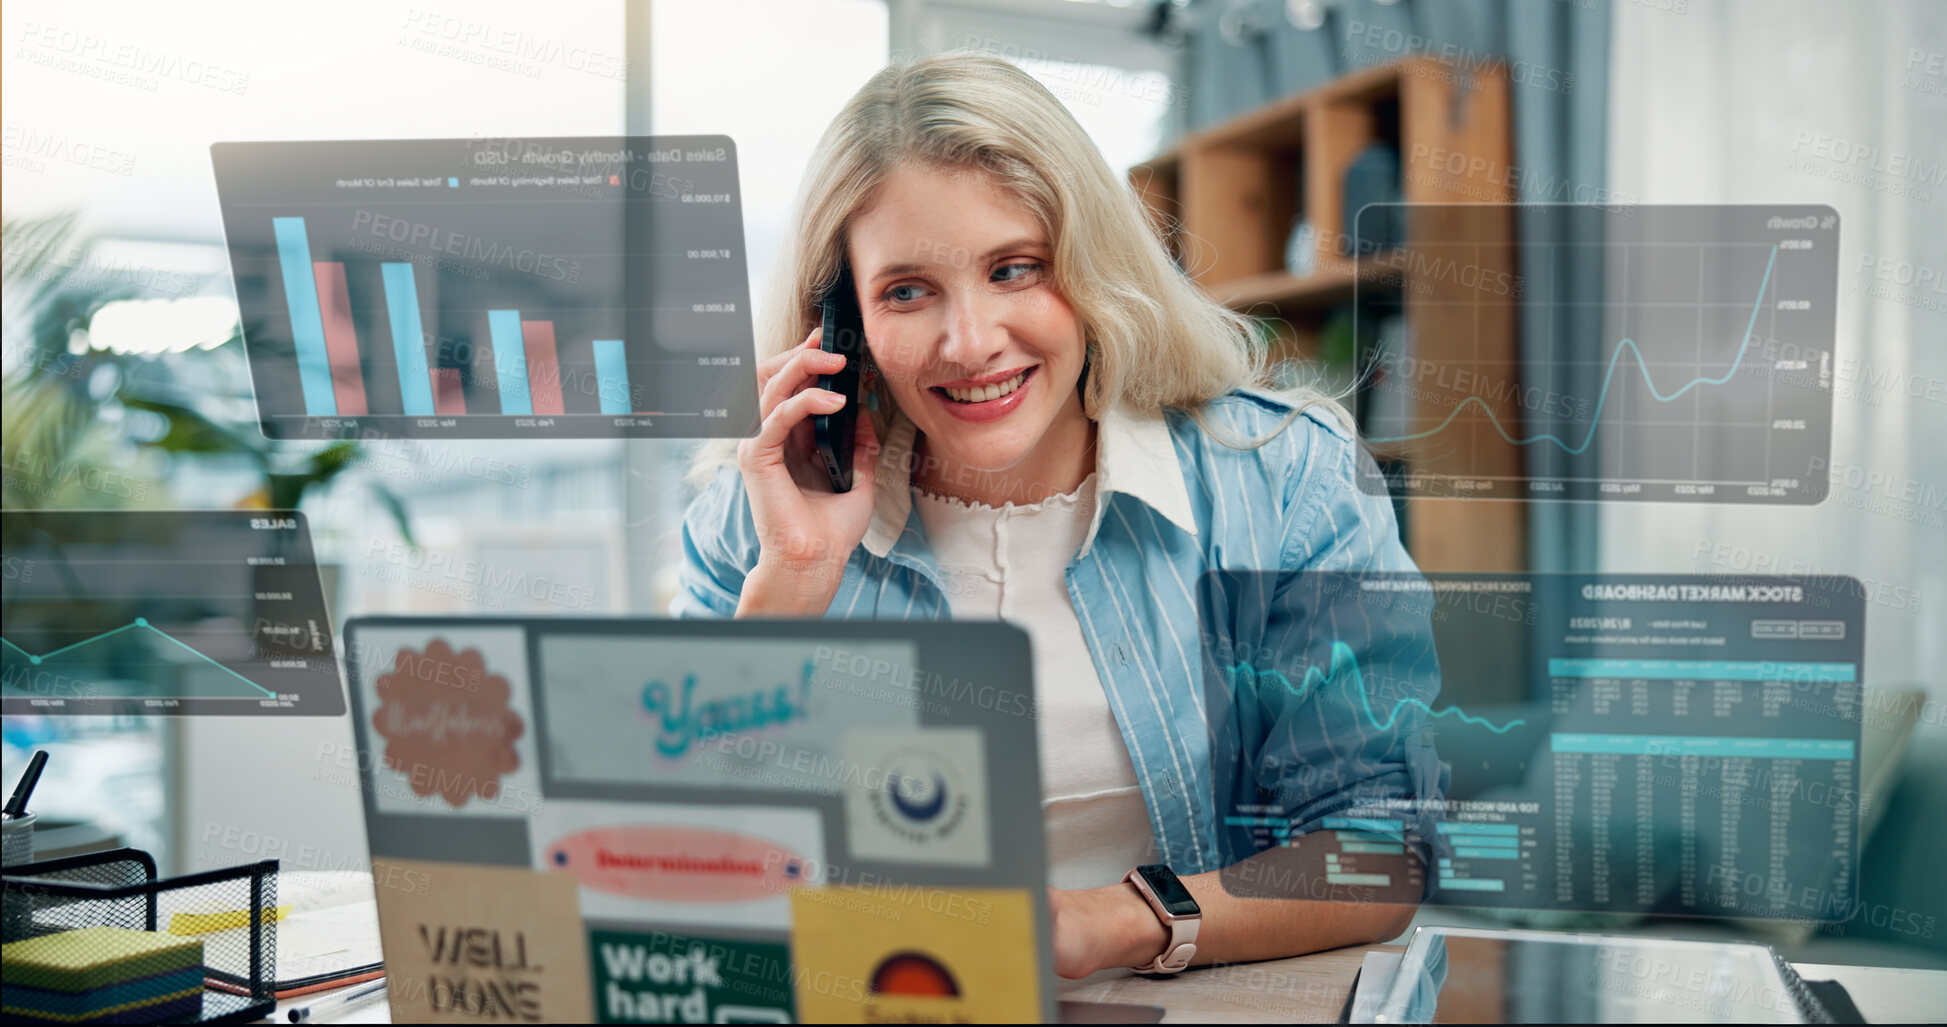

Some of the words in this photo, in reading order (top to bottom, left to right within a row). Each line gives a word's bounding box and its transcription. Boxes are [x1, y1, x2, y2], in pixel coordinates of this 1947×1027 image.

[418, 923, 545, 972] WELL
[602, 942, 720, 988] Work
[606, 980, 707, 1023] hard
